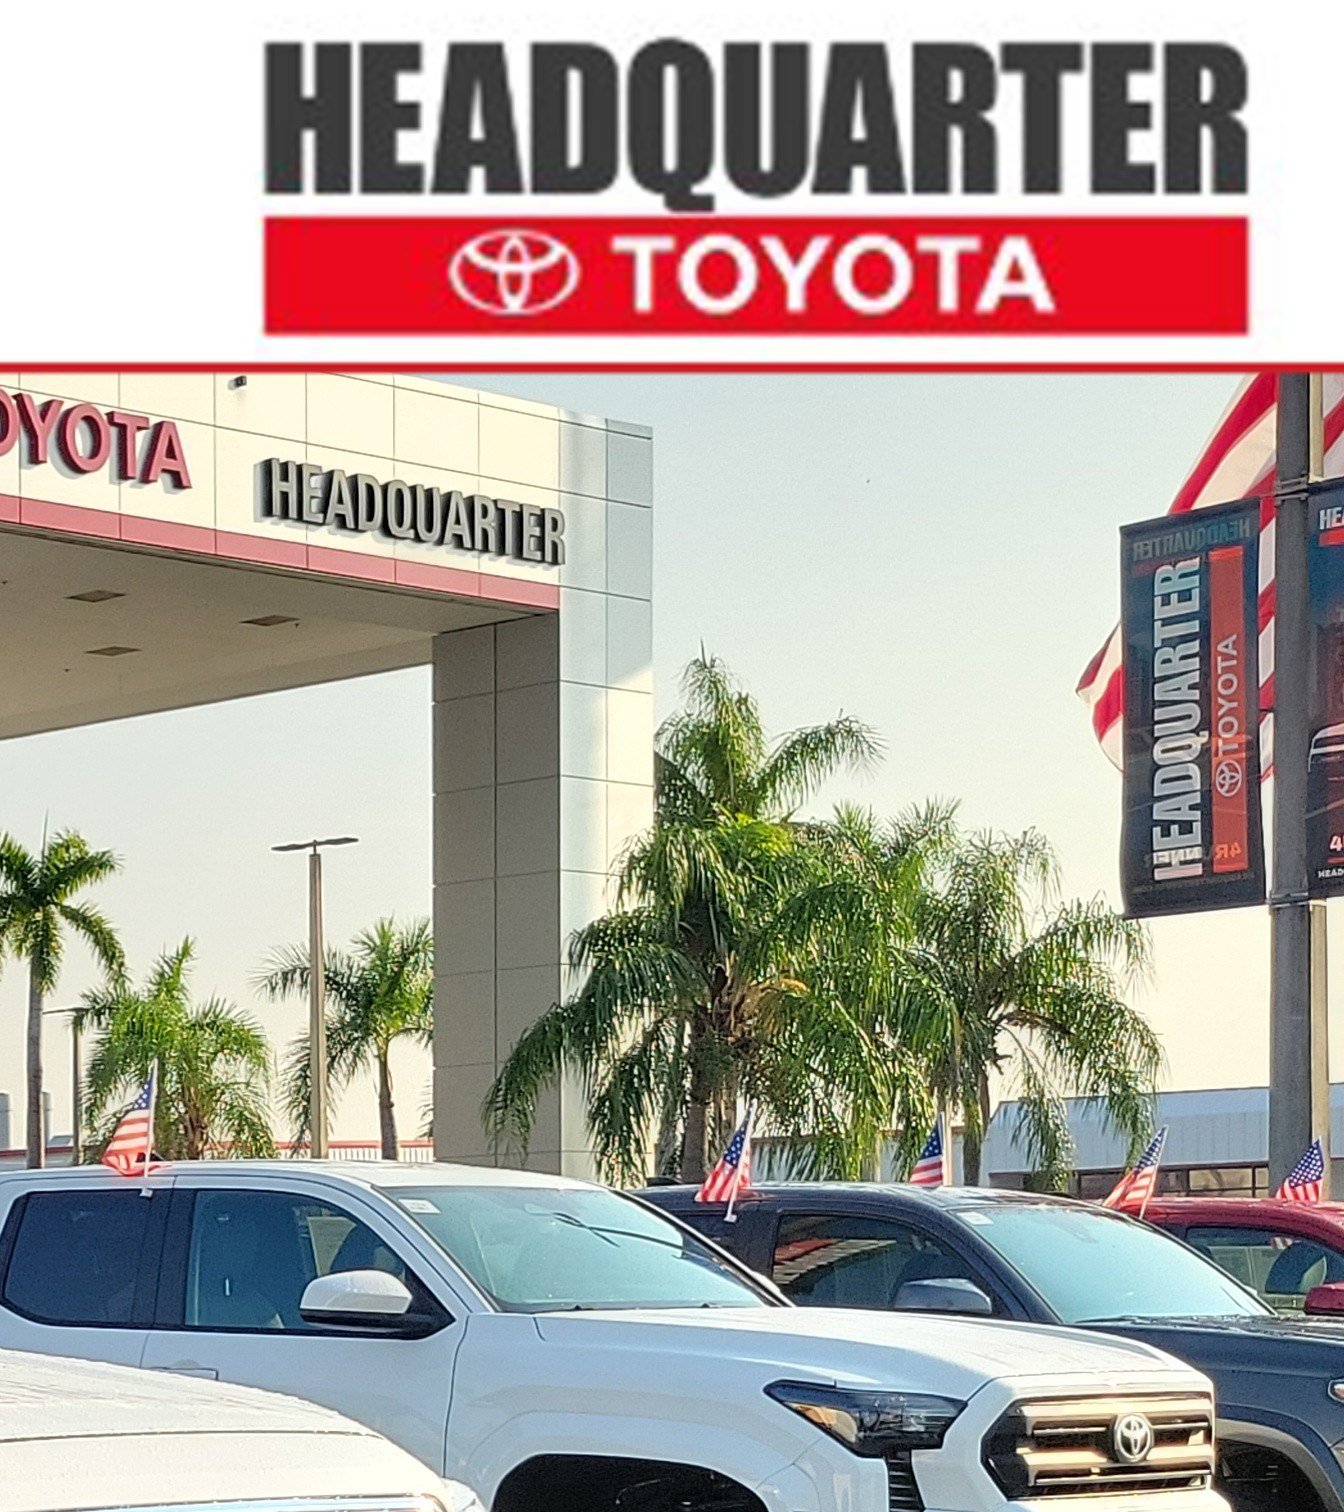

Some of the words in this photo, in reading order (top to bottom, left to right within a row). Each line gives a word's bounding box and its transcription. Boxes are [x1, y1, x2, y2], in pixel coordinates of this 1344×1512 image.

[264, 458, 566, 566] HEADQUARTER
[1319, 506, 1344, 530] HE
[1153, 555, 1209, 881] HEADQUARTER
[1216, 633, 1238, 755] TOYOTA
